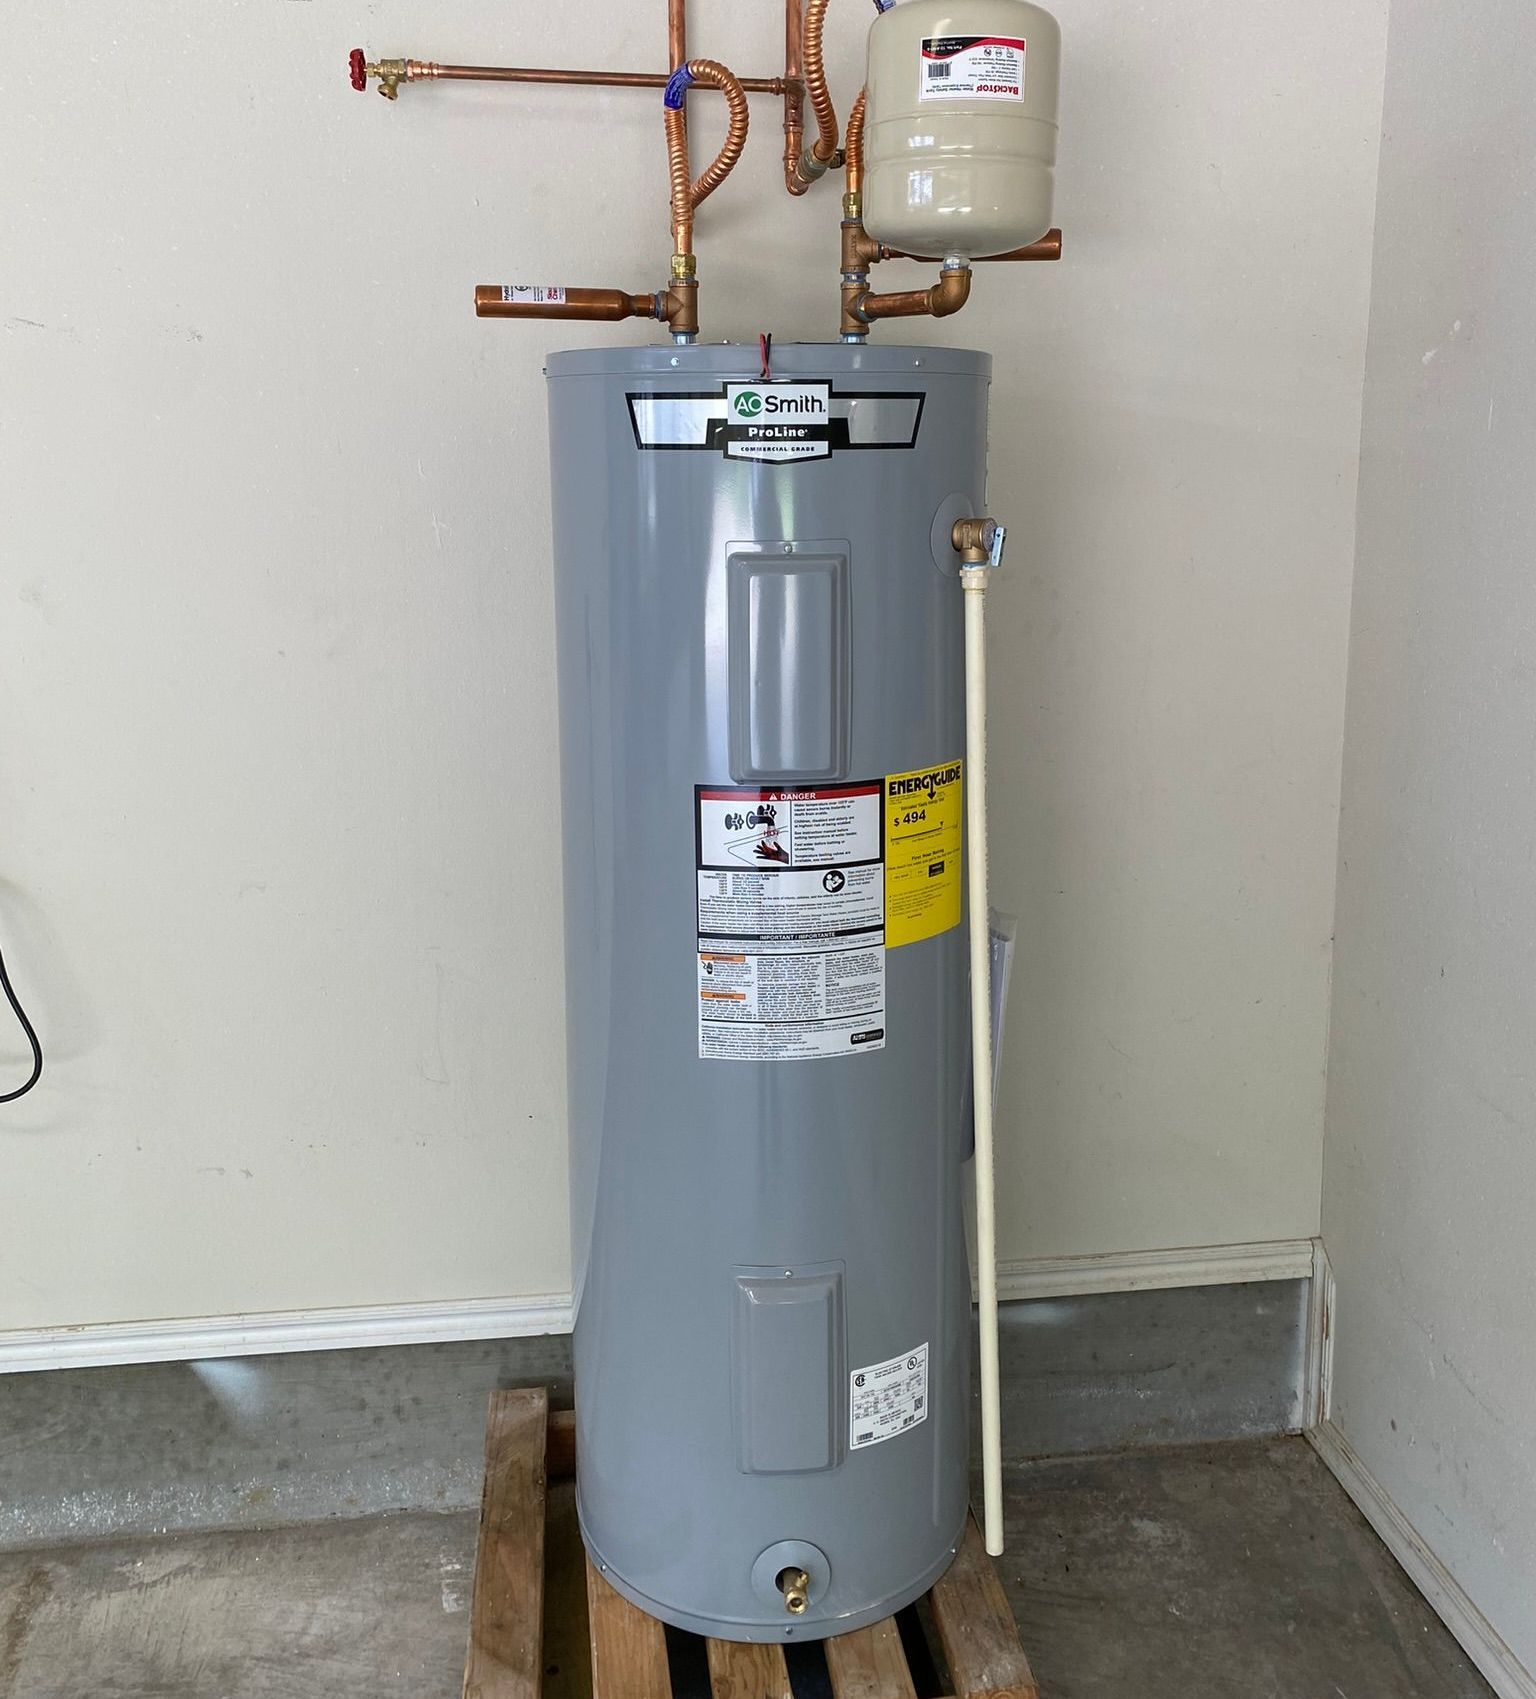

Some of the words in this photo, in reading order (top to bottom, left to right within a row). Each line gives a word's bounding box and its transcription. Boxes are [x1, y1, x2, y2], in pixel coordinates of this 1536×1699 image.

[889, 765, 961, 797] ENERGYGUIDE
[894, 818, 900, 827] $
[903, 809, 926, 824] 494
